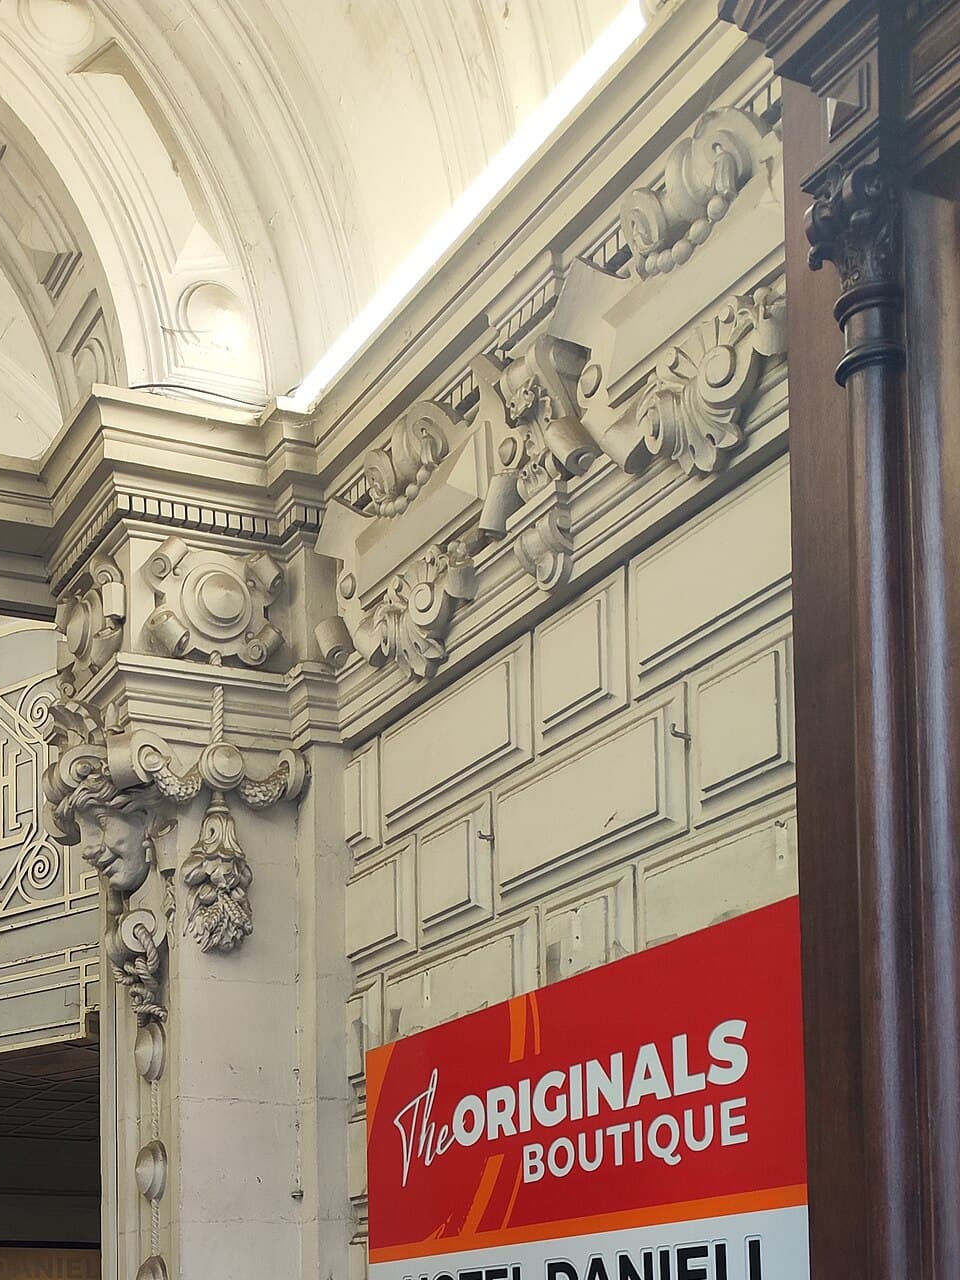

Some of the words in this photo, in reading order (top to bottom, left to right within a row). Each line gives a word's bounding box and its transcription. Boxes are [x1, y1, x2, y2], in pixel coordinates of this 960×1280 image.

[393, 1067, 457, 1187] The
[452, 1018, 749, 1148] ORIGINALS
[523, 1096, 749, 1184] BOUTIQUE
